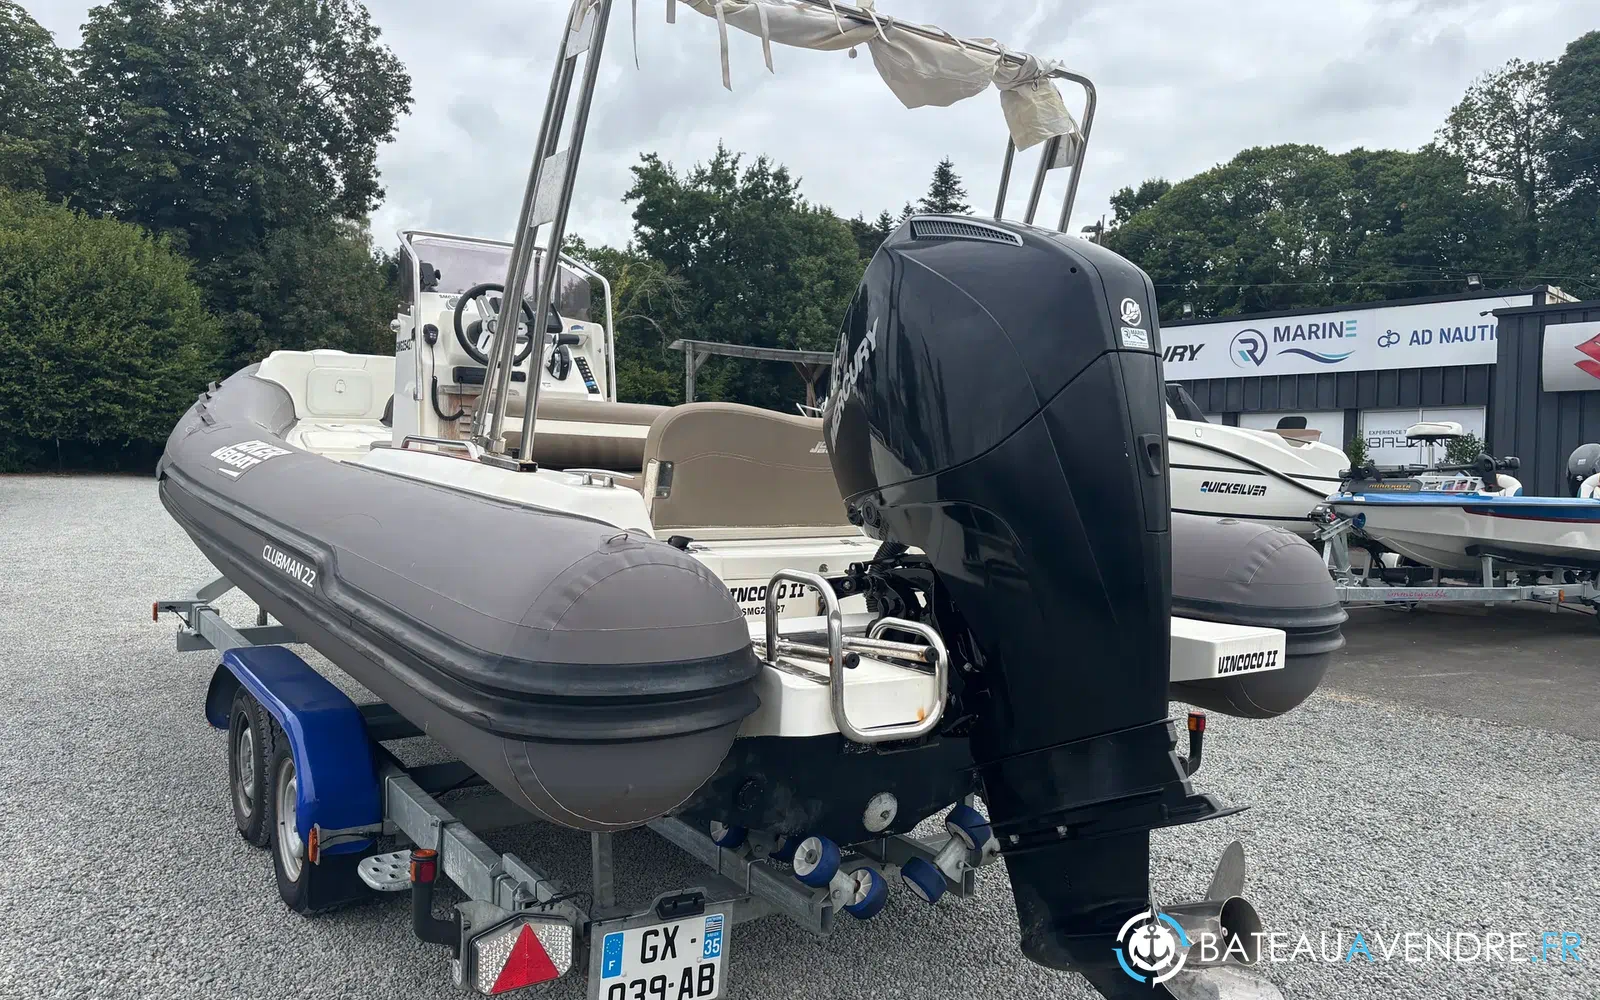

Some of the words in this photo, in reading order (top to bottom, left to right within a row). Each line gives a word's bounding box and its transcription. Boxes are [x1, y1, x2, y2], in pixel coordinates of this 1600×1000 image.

[1273, 319, 1357, 343] MARINE
[1409, 329, 1433, 346] AD
[1200, 481, 1267, 497] QUICKSILVER
[262, 544, 304, 580] CLUBMAN
[301, 566, 316, 588] 22
[727, 583, 787, 603] INCOO
[741, 604, 786, 616] SMG227
[1218, 651, 1265, 674] VINCOCO
[704, 937, 720, 955] 35
[608, 960, 616, 971] F
